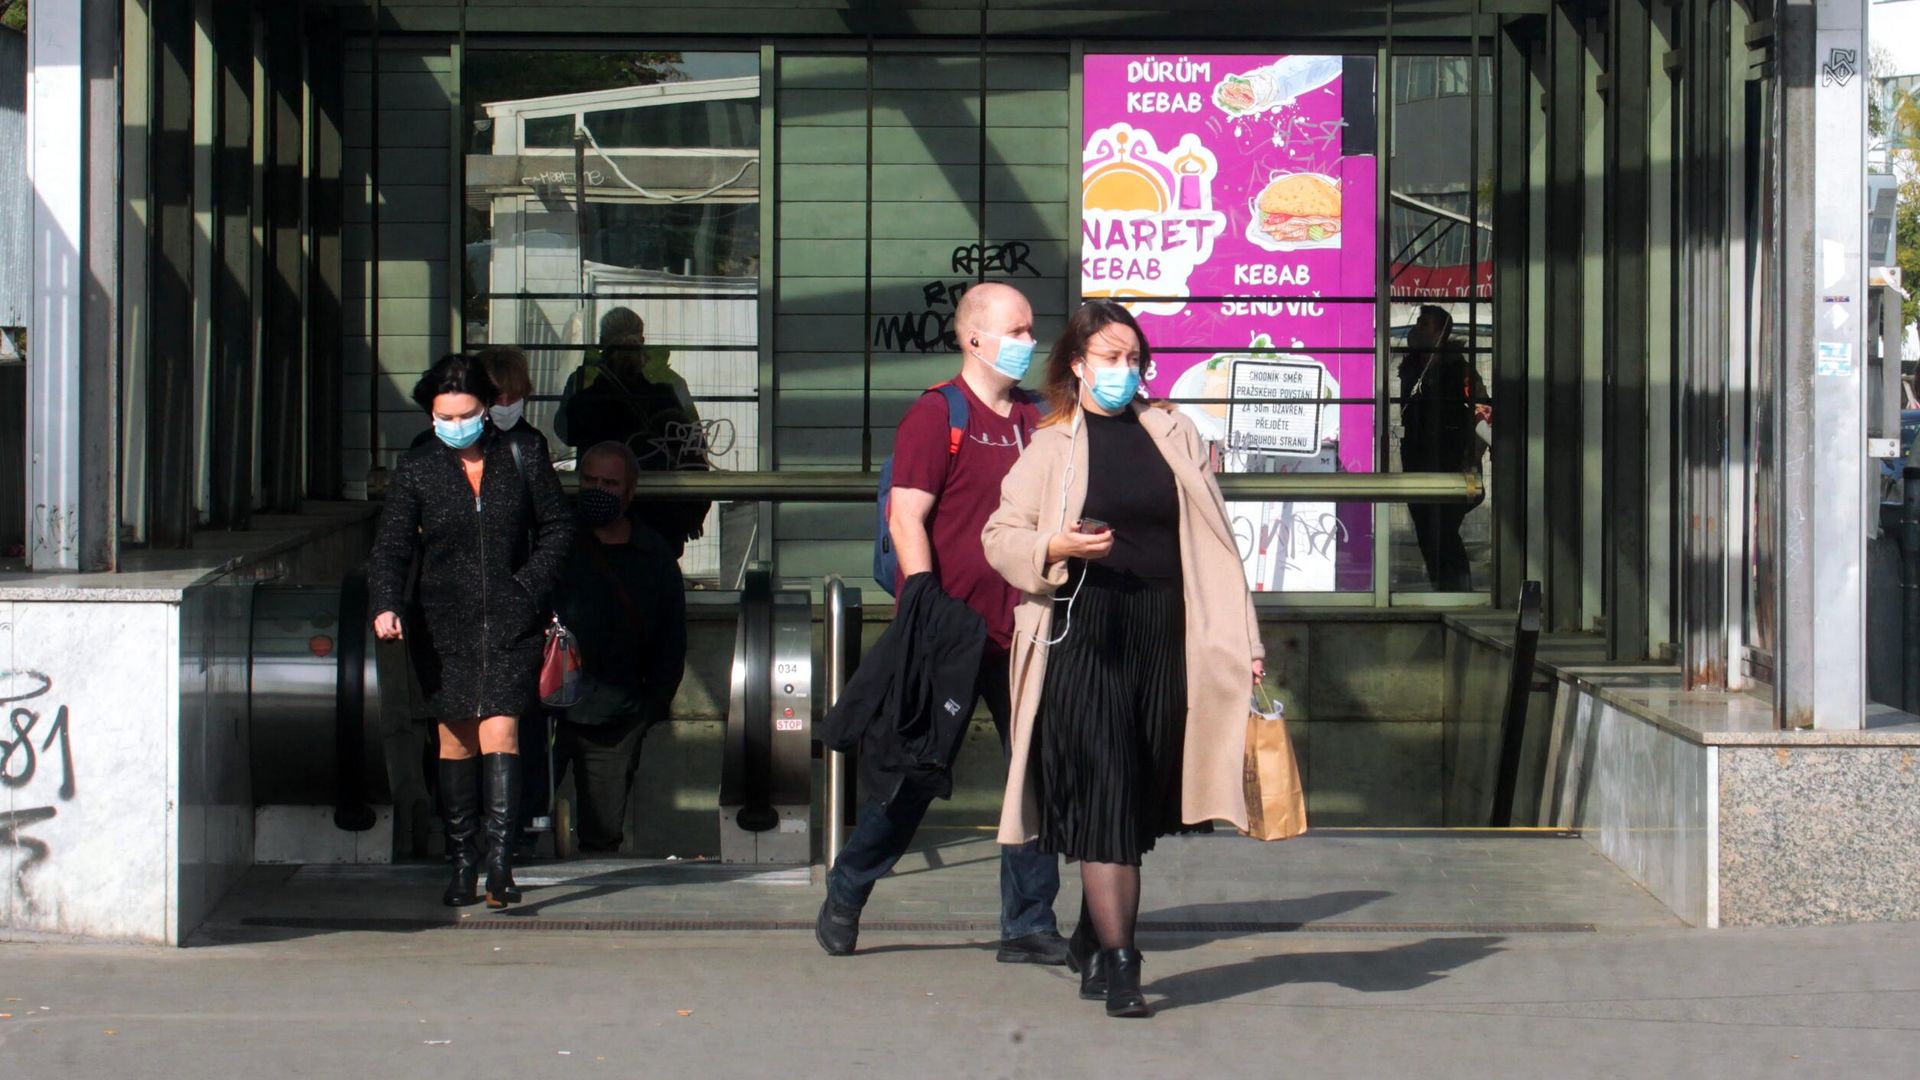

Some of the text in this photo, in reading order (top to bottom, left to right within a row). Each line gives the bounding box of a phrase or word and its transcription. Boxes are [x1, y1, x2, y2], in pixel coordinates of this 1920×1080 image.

[1127, 56, 1211, 83] DÜRÜM
[1127, 91, 1203, 113] KEBAB
[1081, 218, 1216, 252] NARET
[1234, 263, 1311, 286] KEBAB
[1220, 290, 1325, 317] SENDVIČ
[1249, 371, 1303, 384] CHODNÍK SMĚR
[1236, 384, 1313, 399] PRAŽSKÉHO POVSTÁNÍ
[1242, 403, 1251, 412] ZA
[1255, 403, 1269, 413] 50m
[1256, 417, 1289, 431] PŘEJDĚTE
[1280, 436, 1308, 448] STRANU
[777, 663, 797, 675] 034
[777, 720, 802, 730] STOP
